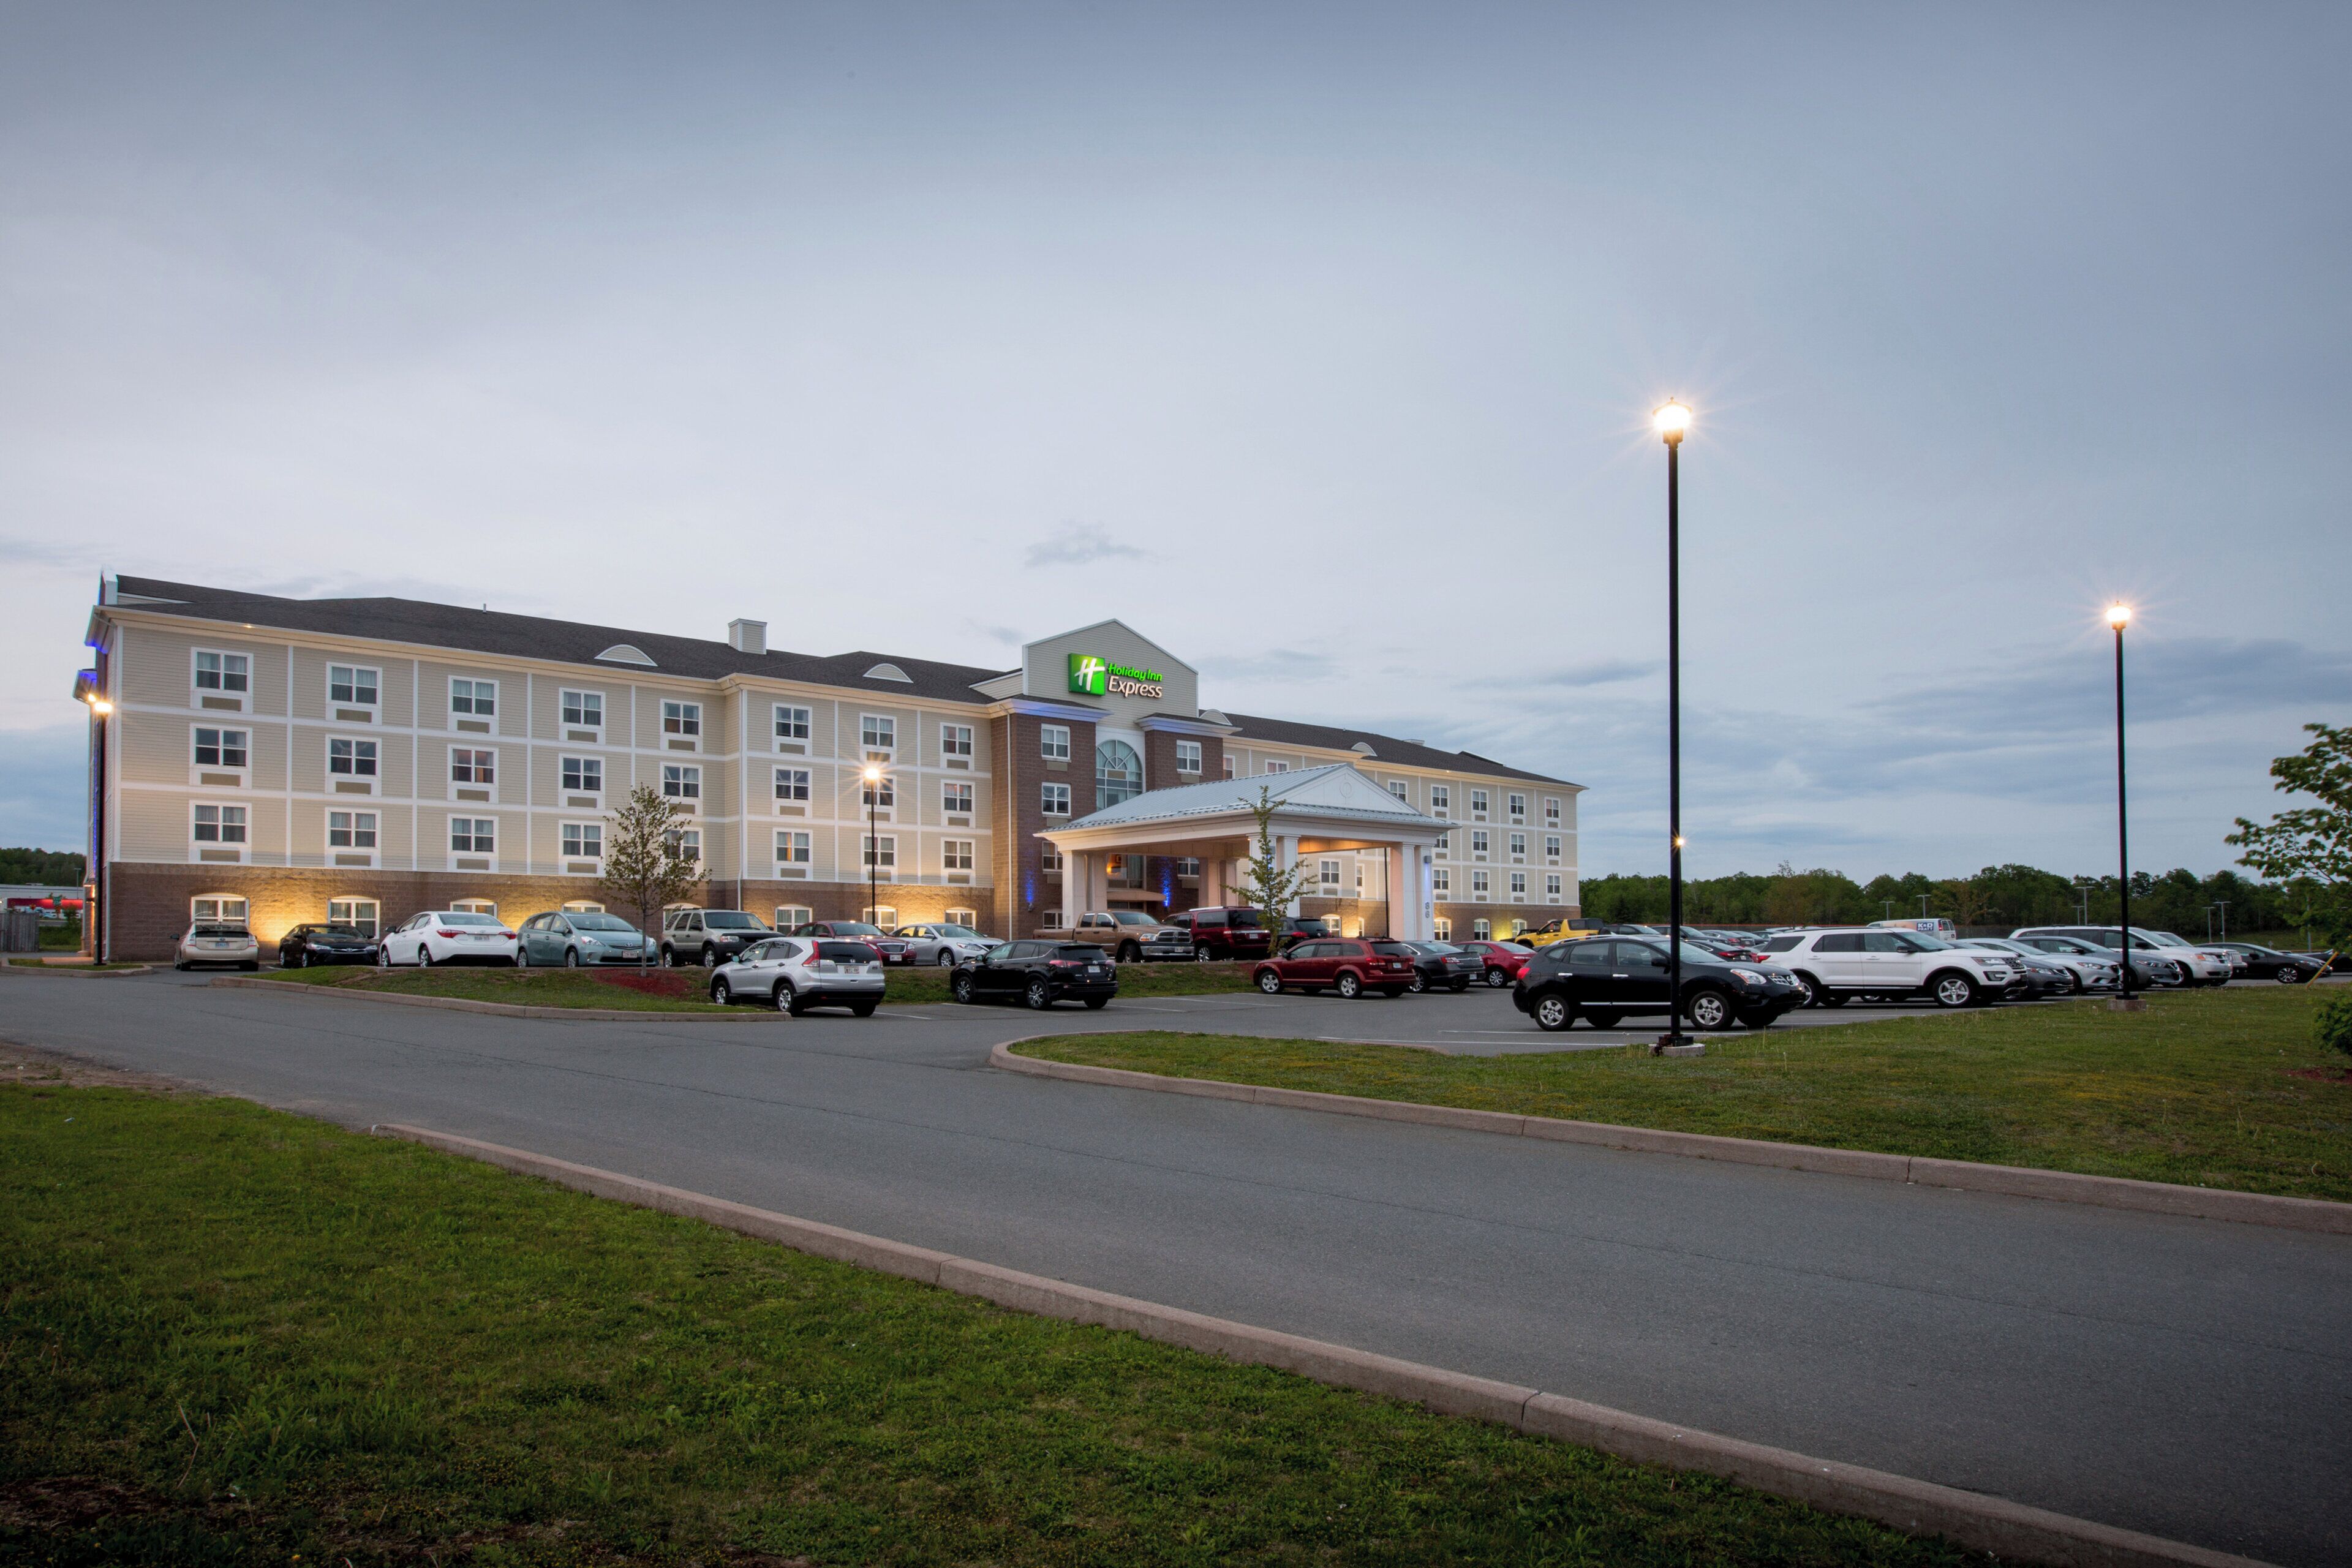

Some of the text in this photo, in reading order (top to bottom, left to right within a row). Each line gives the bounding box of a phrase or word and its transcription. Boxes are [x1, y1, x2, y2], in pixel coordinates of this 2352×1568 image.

[1108, 663, 1163, 682] Holiday Inn
[1108, 676, 1163, 698] Express
